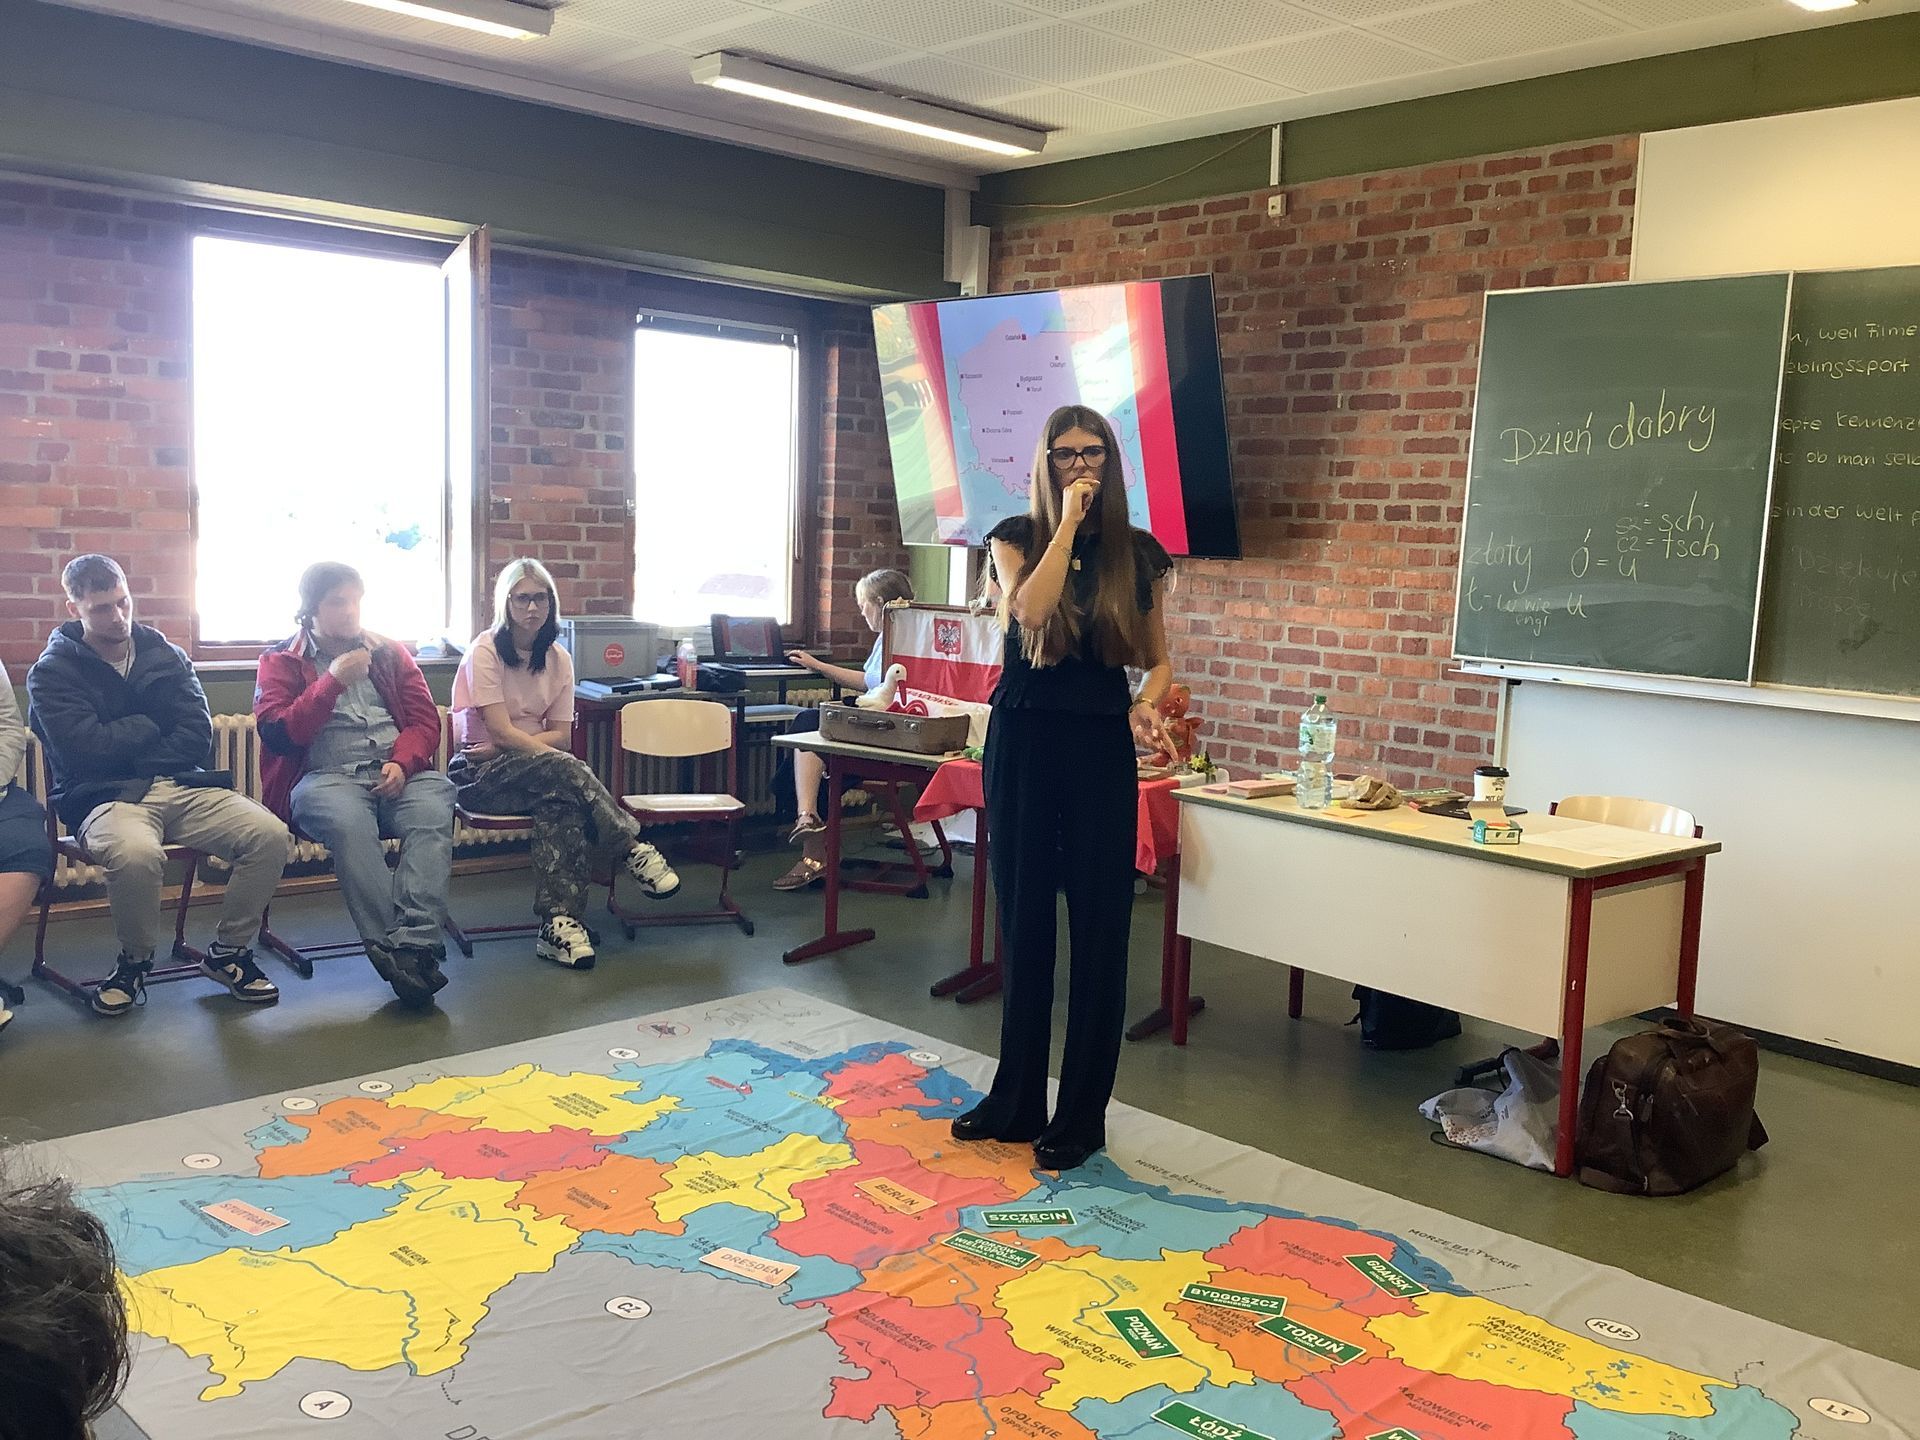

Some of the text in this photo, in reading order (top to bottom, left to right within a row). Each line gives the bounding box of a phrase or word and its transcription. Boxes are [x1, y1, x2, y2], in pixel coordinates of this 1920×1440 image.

[1818, 327, 1858, 340] weil
[1865, 322, 1918, 339] Filme
[1499, 388, 1716, 466] Dzień dobry
[1835, 411, 1920, 431] kennenz
[1806, 451, 1829, 464] ob
[1837, 454, 1876, 467] man
[874, 1184, 920, 1206] BERLIN
[988, 1212, 1068, 1221] SZCZECIN
[954, 1236, 1028, 1263] WIELKOPOLSKI
[1407, 1229, 1521, 1270] MORZE BAŁTYCKIE
[720, 1253, 785, 1275] DRESDEN
[1366, 1260, 1414, 1291] GDAŃSK
[1190, 1287, 1279, 1309] BYDGOSZCZ
[1124, 1315, 1168, 1351] POZNAŃ
[1282, 1323, 1345, 1354] TORUŃ
[1592, 1320, 1634, 1339] RUS
[1044, 1324, 1137, 1369] WIELKOPOLSKIE
[313, 1400, 335, 1411] A
[1397, 1385, 1493, 1432] MAZOWIECKIE
[1826, 1404, 1855, 1417] LT
[1000, 1405, 1062, 1440] OPOLSKIE
[1001, 1416, 1038, 1439] OPPELN
